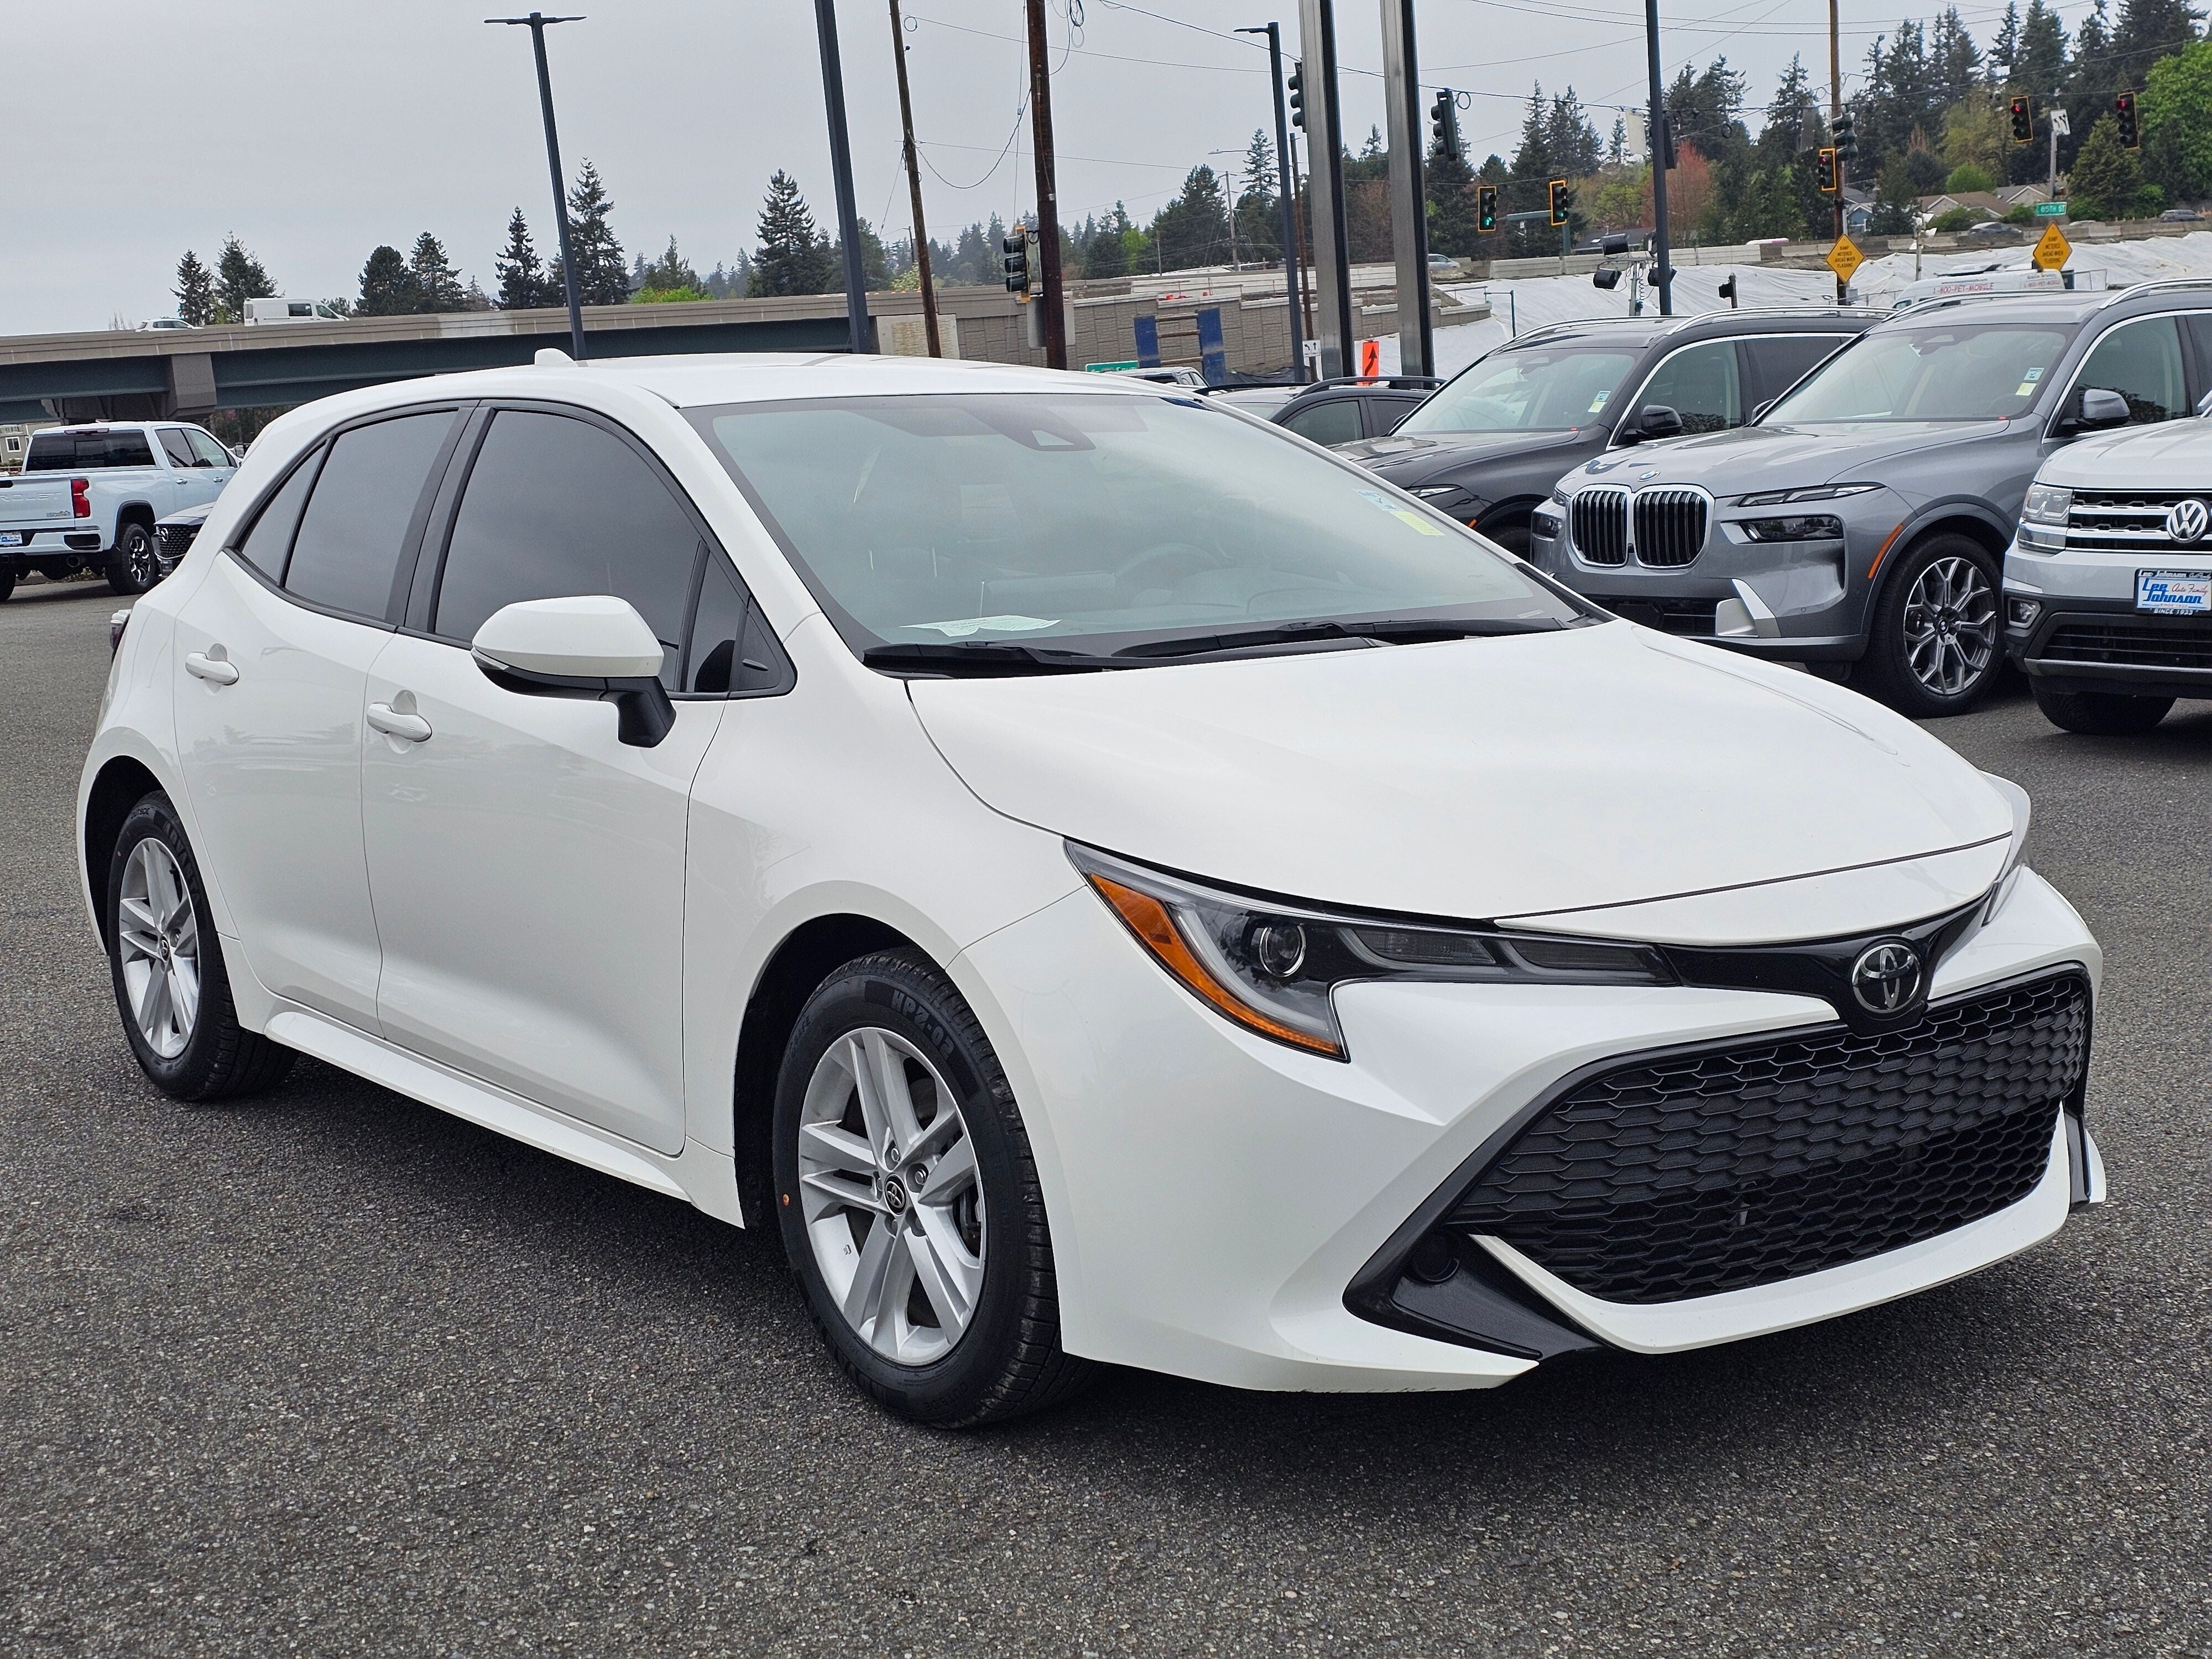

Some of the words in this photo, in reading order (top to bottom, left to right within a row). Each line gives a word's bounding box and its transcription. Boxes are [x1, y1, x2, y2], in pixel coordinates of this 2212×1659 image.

[1933, 282, 1994, 294] 1-800-PET-MOBILE
[2142, 578, 2169, 592] Lee
[2143, 589, 2203, 604] Johnson
